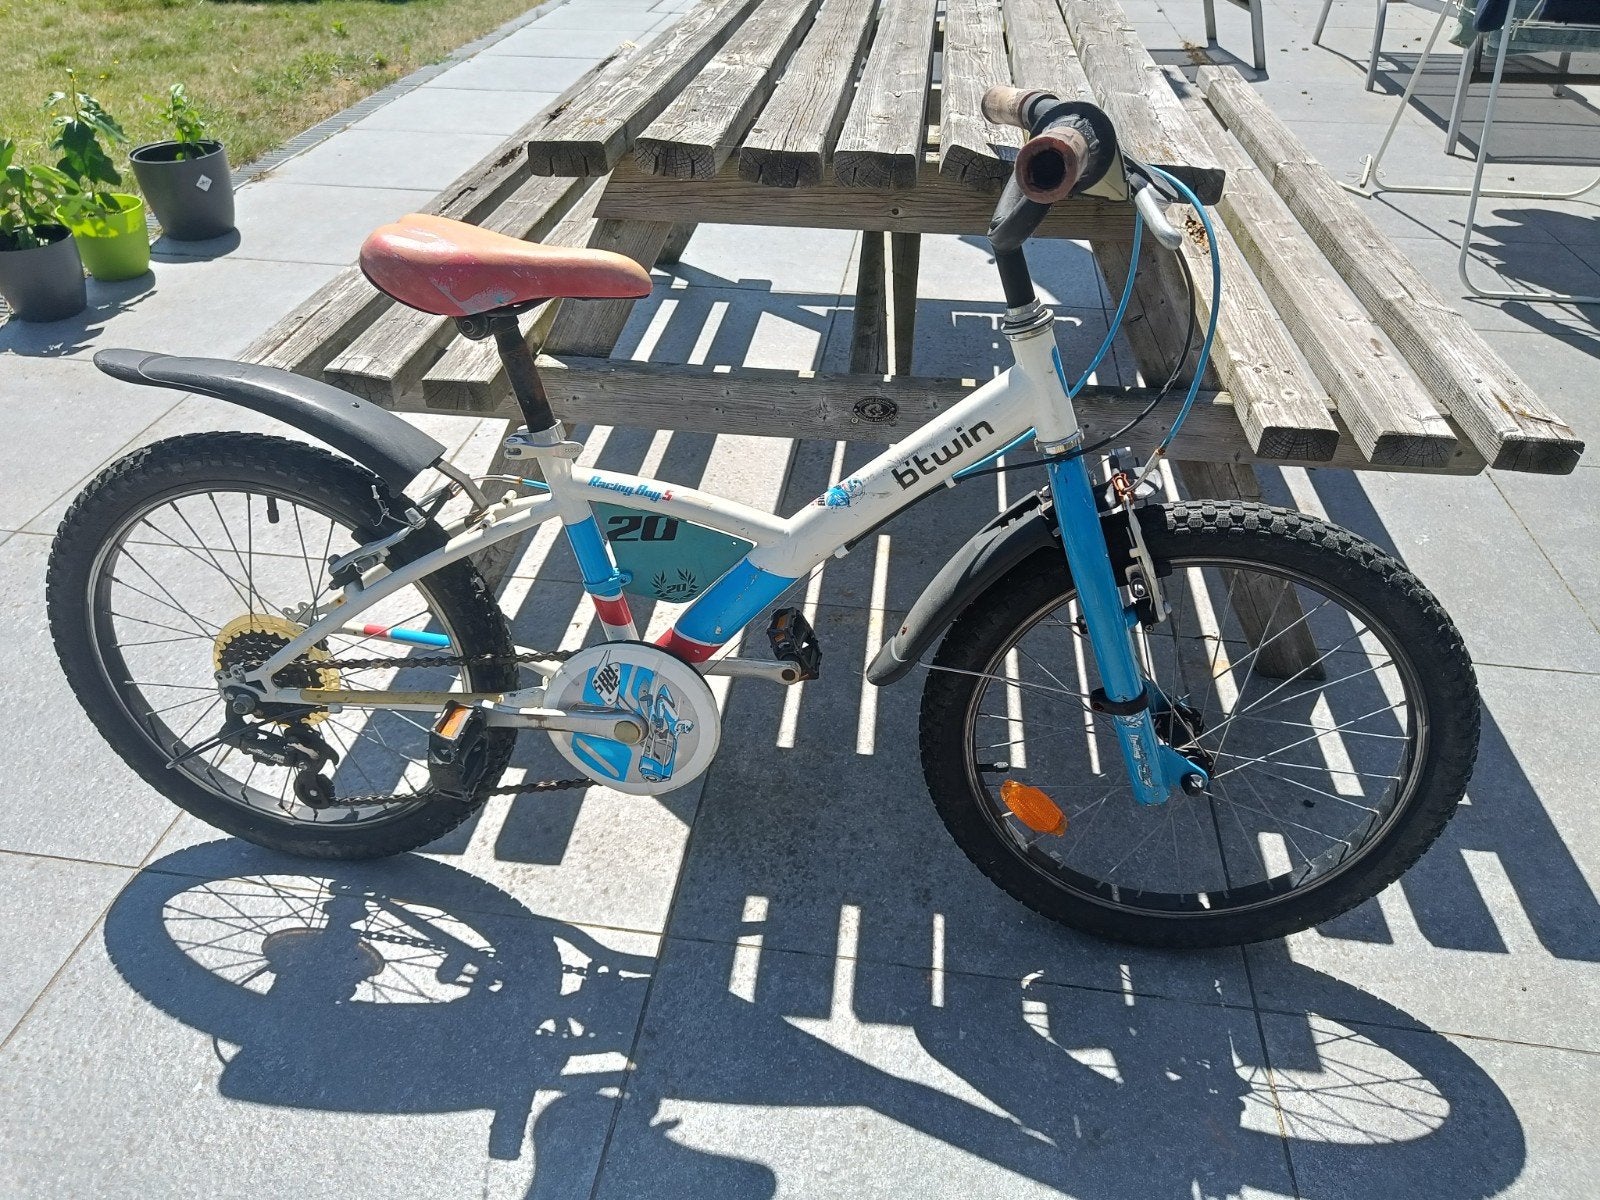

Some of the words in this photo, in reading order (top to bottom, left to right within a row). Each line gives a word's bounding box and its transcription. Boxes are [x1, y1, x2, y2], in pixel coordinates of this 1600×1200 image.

[588, 475, 633, 496] Racing
[607, 515, 679, 542] 20
[666, 582, 687, 593] 20
